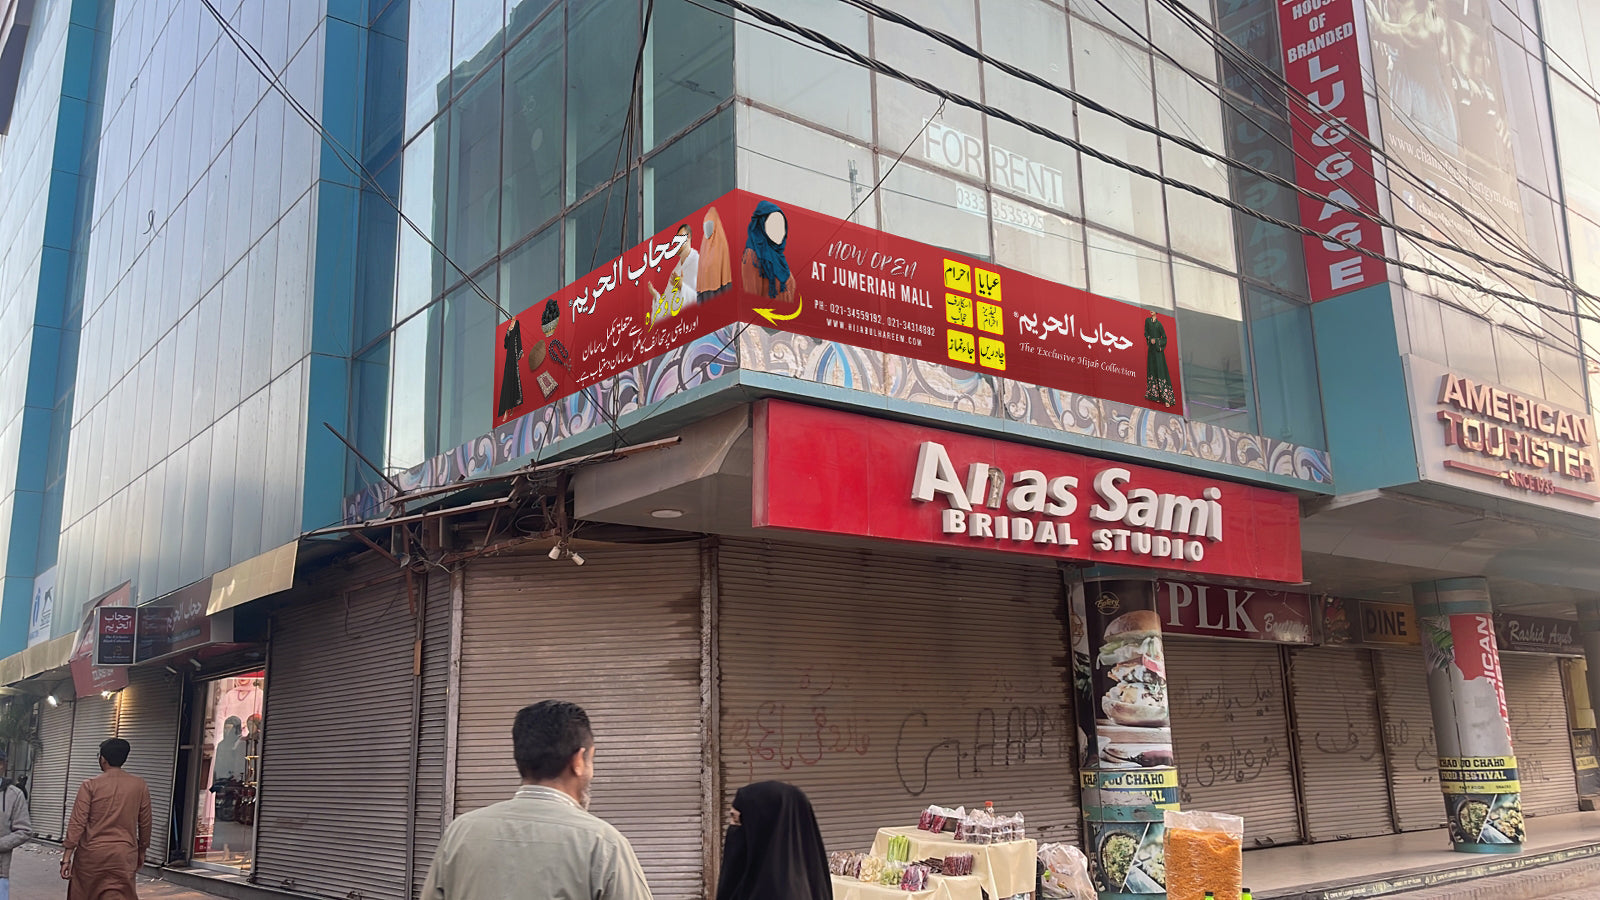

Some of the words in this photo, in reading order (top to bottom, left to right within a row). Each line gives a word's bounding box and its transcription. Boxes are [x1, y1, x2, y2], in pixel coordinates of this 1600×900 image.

[1292, 0, 1336, 20] HOU
[1308, 12, 1326, 33] OF
[1287, 22, 1354, 64] BRANDED
[924, 119, 984, 178] FOR
[991, 146, 1063, 204] RENT
[1307, 55, 1365, 290] LUGGAGE
[957, 187, 986, 212] 0333
[992, 200, 1044, 231] 3535325
[828, 240, 868, 266] NOW
[870, 251, 917, 279] OPEN
[811, 261, 827, 281] AT
[832, 266, 896, 300] JUMERIAH
[901, 284, 934, 309] MALL
[1080, 322, 1134, 353] حجاب
[1019, 342, 1035, 353] The
[1037, 346, 1075, 363] Exclusive
[1077, 357, 1099, 369] Hijab
[1101, 362, 1136, 378] Collection
[1437, 373, 1592, 446] AMERICAN
[1437, 410, 1596, 482] TOURISTER
[911, 441, 1078, 517] Anas
[1089, 467, 1223, 543] Sami
[1507, 469, 1535, 491] SINCE
[942, 508, 1079, 545] BRIDAL
[1092, 529, 1204, 562] STUDIO
[1166, 581, 1259, 633] PLK
[1366, 609, 1407, 636] DINE
[1126, 773, 1164, 785] CHAHO
[1473, 758, 1505, 768] CHAHO
